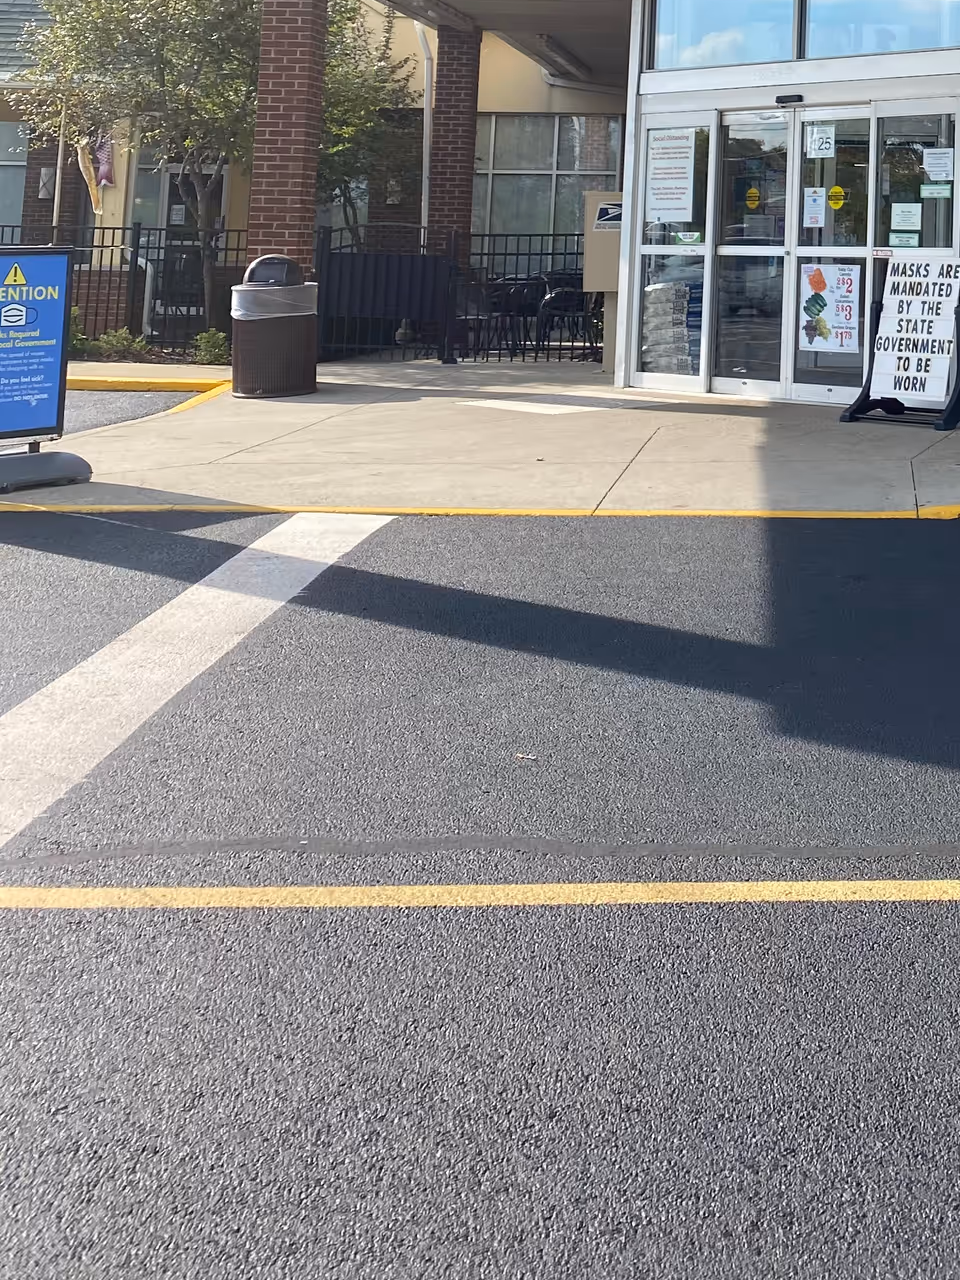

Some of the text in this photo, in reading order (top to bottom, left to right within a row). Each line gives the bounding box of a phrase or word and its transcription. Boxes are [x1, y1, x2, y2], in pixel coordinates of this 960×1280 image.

[818, 138, 831, 150] 25
[890, 262, 960, 279] MASKS ARE
[890, 281, 952, 298] MANDATED
[898, 299, 942, 316] BY THE
[9, 329, 39, 339] Required
[896, 318, 933, 335] STATE
[15, 339, 56, 347] Government
[876, 336, 953, 355] GOVERNMENT
[897, 356, 931, 373] TO BE
[893, 375, 926, 392] WORN
